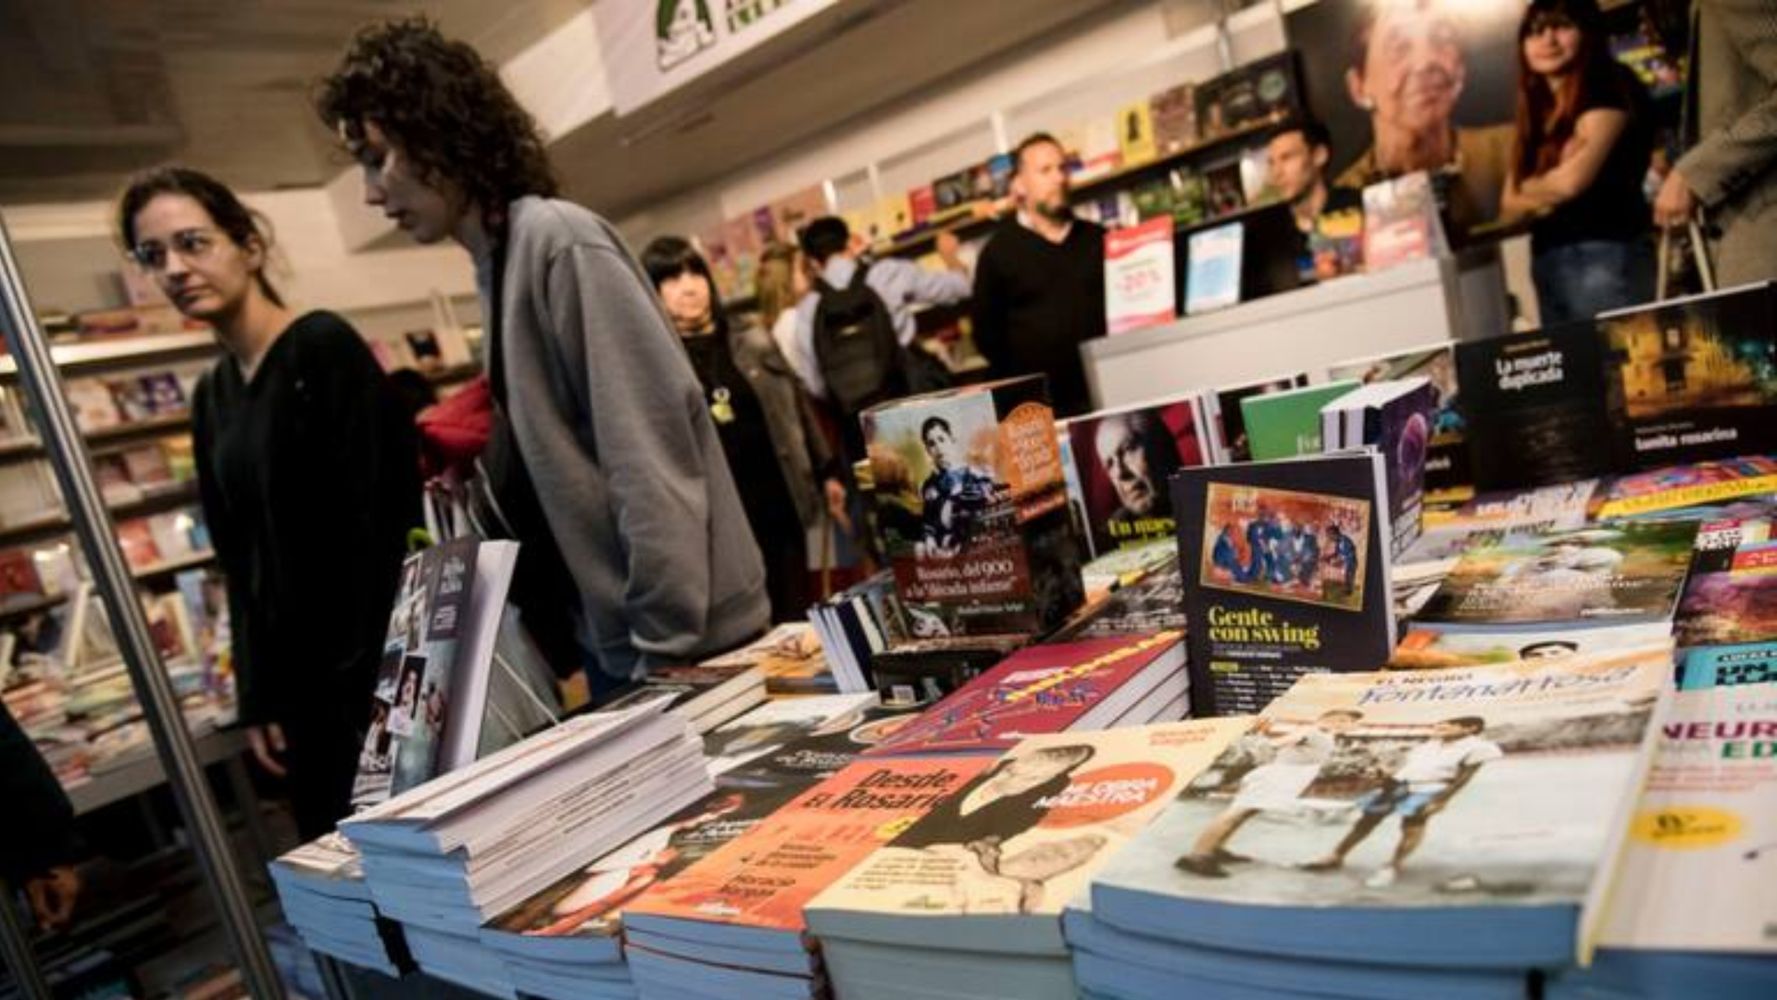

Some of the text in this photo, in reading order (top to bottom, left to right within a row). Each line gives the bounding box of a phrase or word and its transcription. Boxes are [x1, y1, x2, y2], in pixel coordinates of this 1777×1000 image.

[1208, 605, 1274, 627] Gente
[1208, 621, 1321, 650] con swing
[857, 768, 958, 788] Desde
